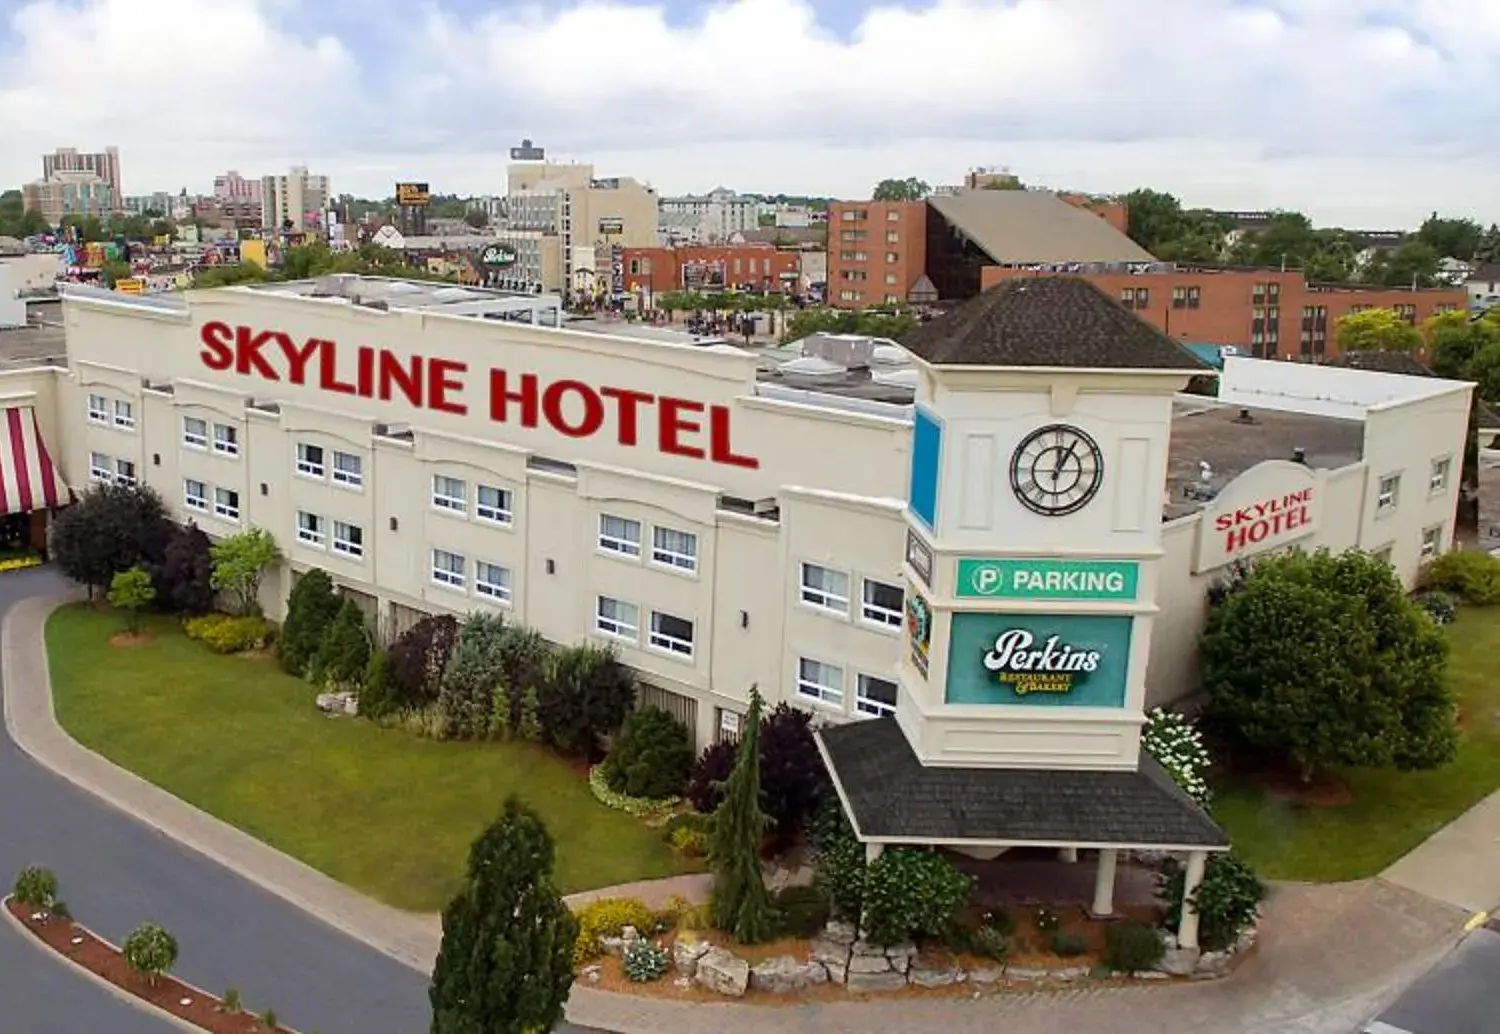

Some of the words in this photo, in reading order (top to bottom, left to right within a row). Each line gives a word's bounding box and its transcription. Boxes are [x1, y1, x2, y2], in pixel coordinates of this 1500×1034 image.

[200, 320, 468, 416] SKYLINE
[489, 367, 760, 470] HOTEL
[1215, 487, 1314, 532] SKYLINE
[1226, 505, 1313, 553] HOTEL
[1012, 570, 1125, 592] PARKING
[983, 628, 1101, 673] Perkins
[999, 672, 1073, 683] RESTAURANT
